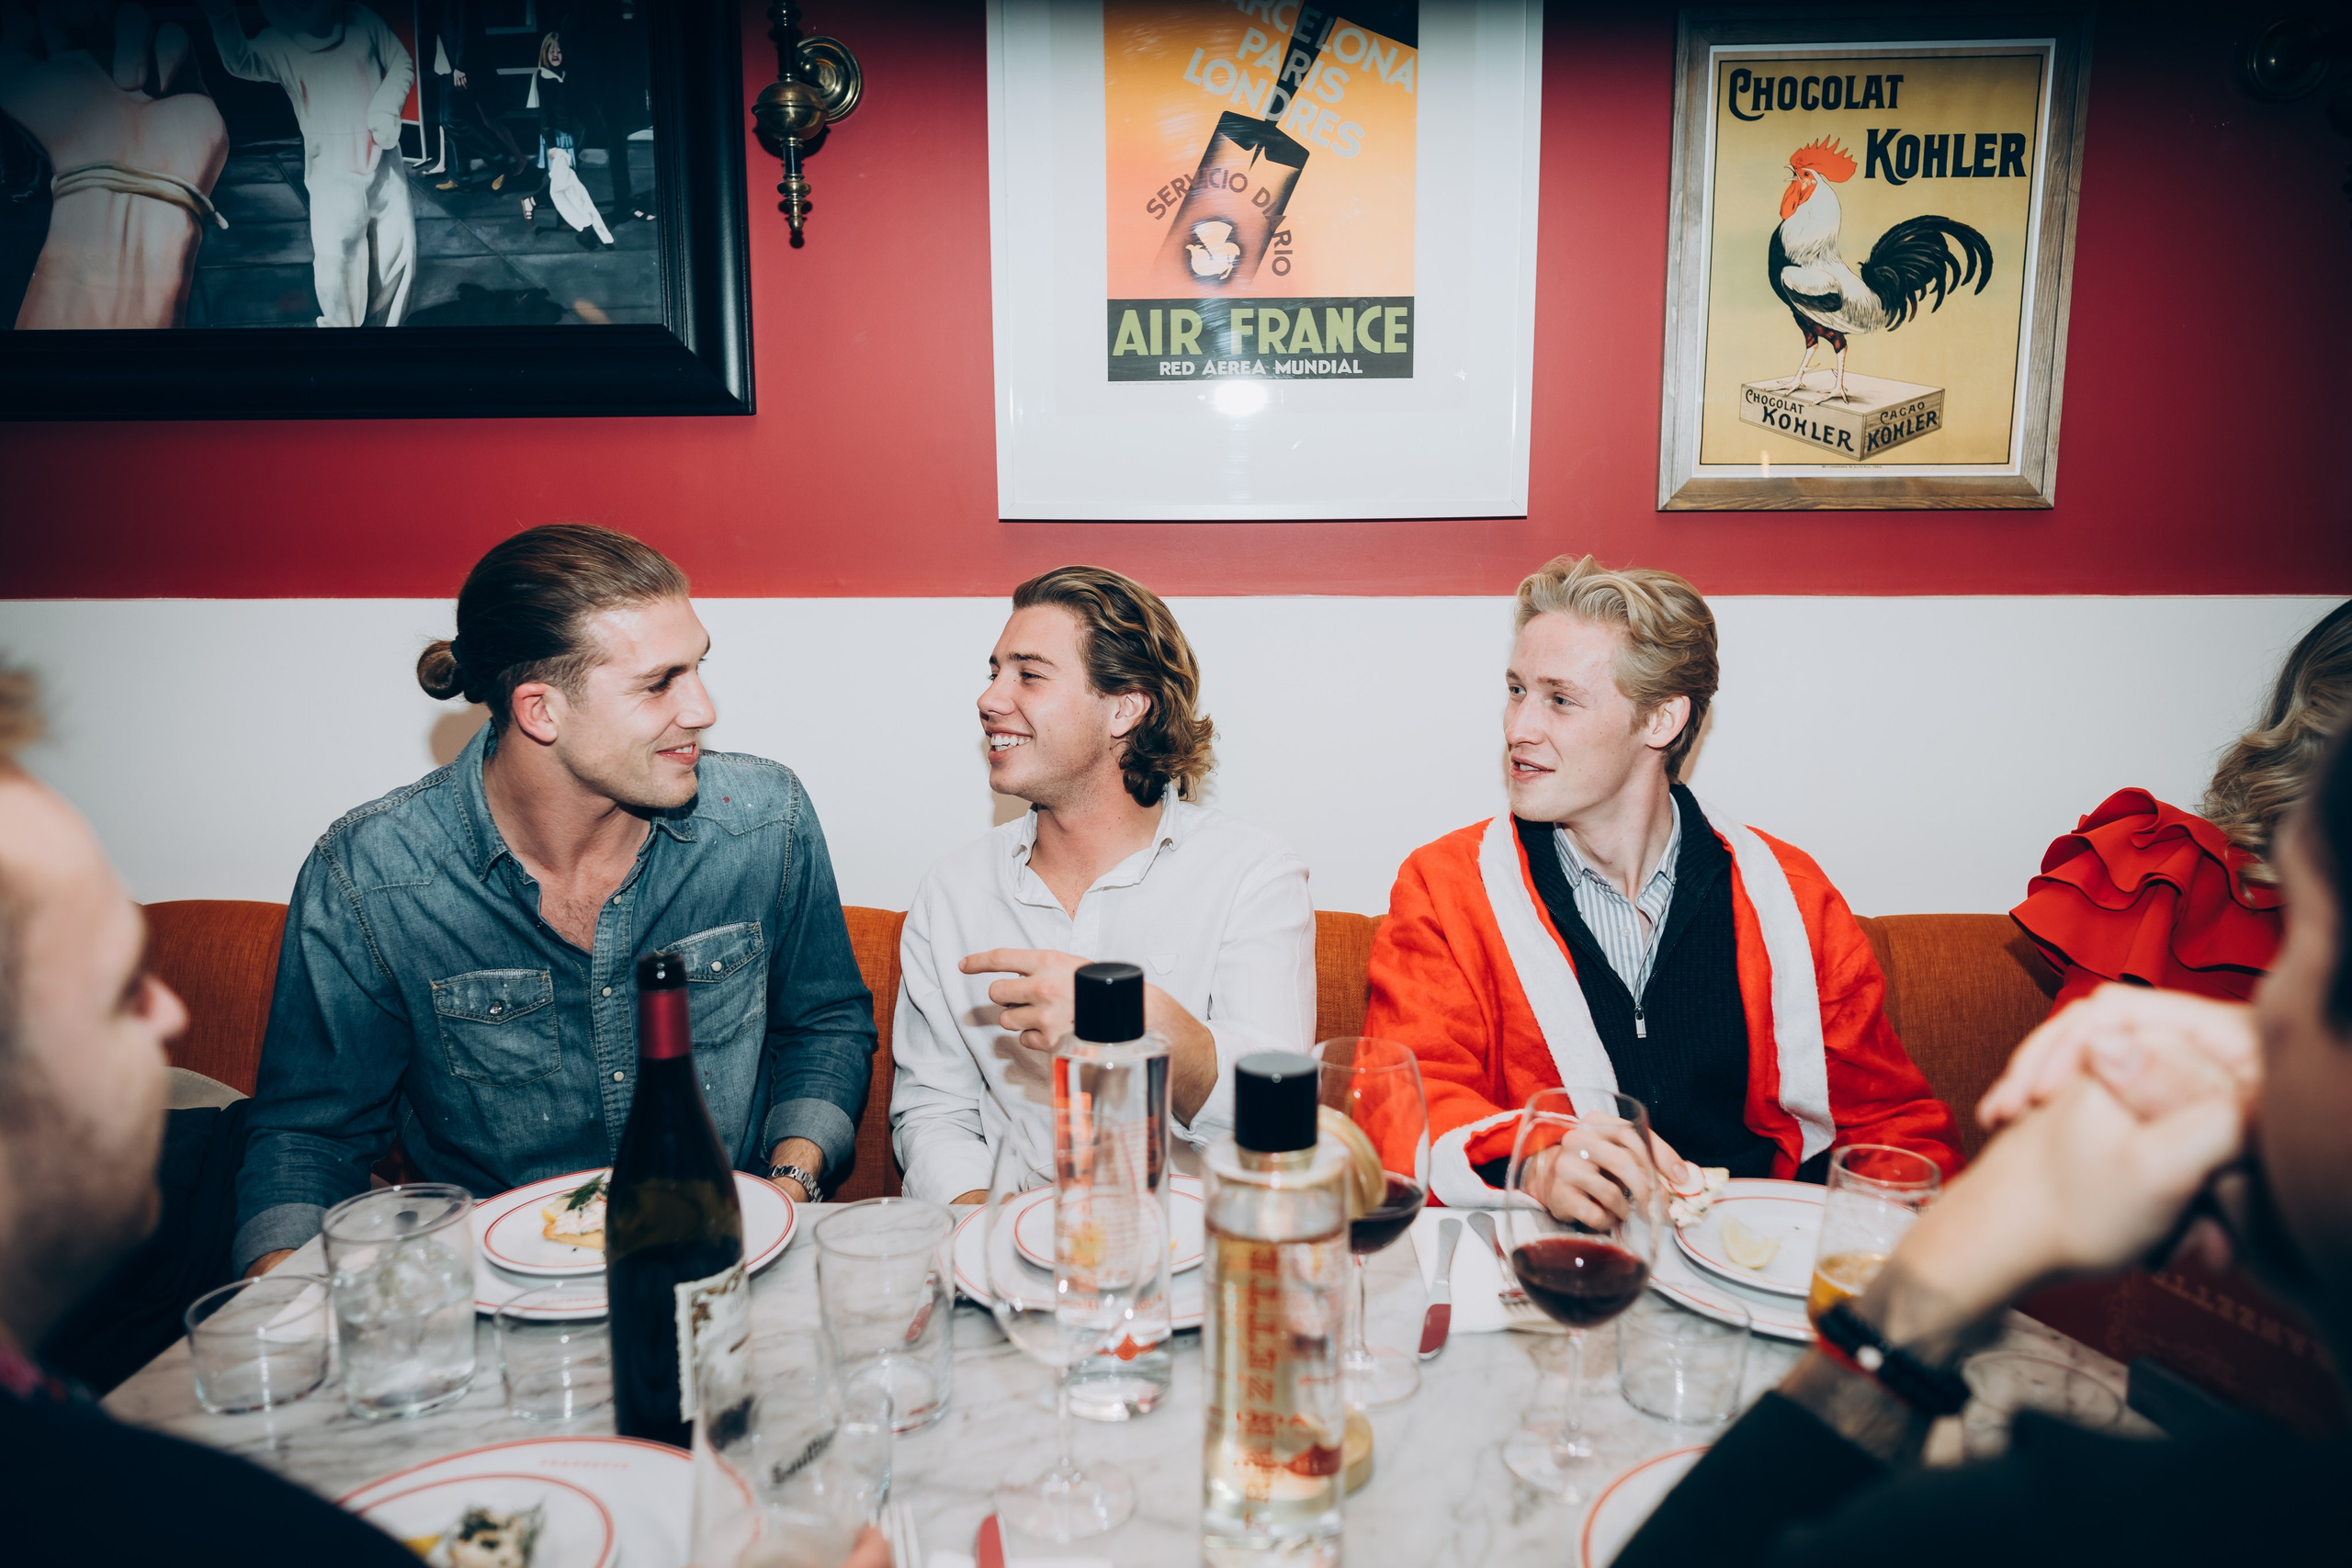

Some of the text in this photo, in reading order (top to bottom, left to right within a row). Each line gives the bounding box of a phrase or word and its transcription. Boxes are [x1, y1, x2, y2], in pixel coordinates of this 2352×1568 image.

[1236, 27, 1350, 104] PARIS
[1182, 47, 1365, 158] LONDRES
[1728, 68, 1905, 121] CHOCOLAT
[1863, 129, 2028, 186] KOHLER
[1112, 305, 1408, 356] AIR FRANCE
[1159, 357, 1363, 377] RED AEREA MUNDIAL
[1745, 389, 1805, 415] CHOCOLAT
[1879, 401, 1926, 425] CACAO
[1761, 406, 1855, 453] KOHLER
[1866, 411, 1939, 453] KOHLER
